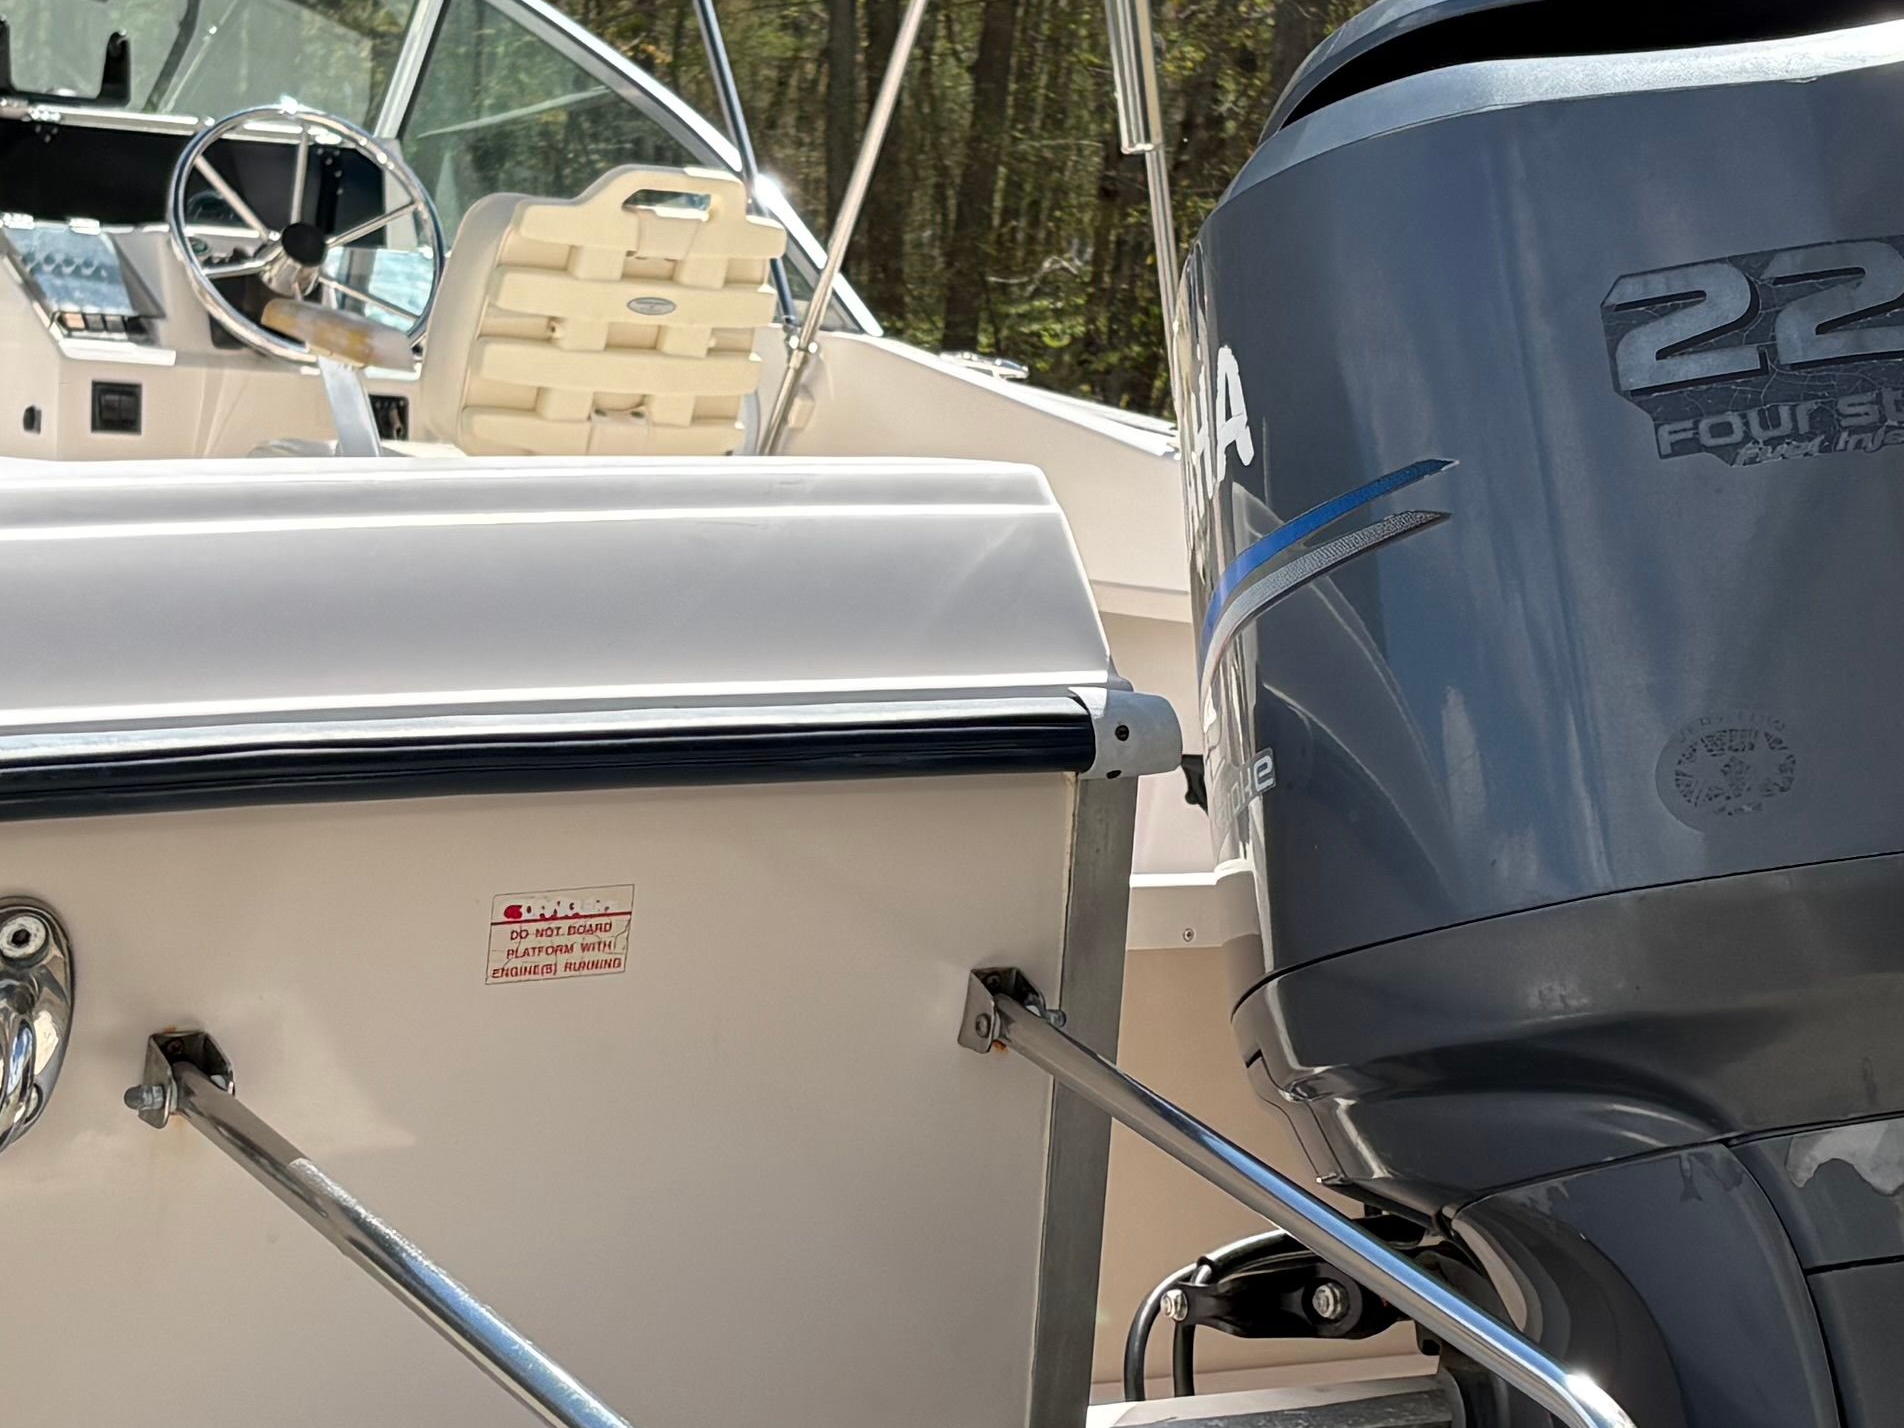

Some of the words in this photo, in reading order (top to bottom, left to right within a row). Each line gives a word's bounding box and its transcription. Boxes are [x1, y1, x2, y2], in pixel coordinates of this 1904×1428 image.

[510, 929, 529, 941] DO
[535, 926, 561, 939] NOT
[567, 921, 613, 936] BOARD
[506, 942, 576, 959] PLATFORM
[580, 940, 613, 954] WITH
[491, 963, 558, 979] ENGINE(S)
[563, 957, 622, 973] RUNNING
